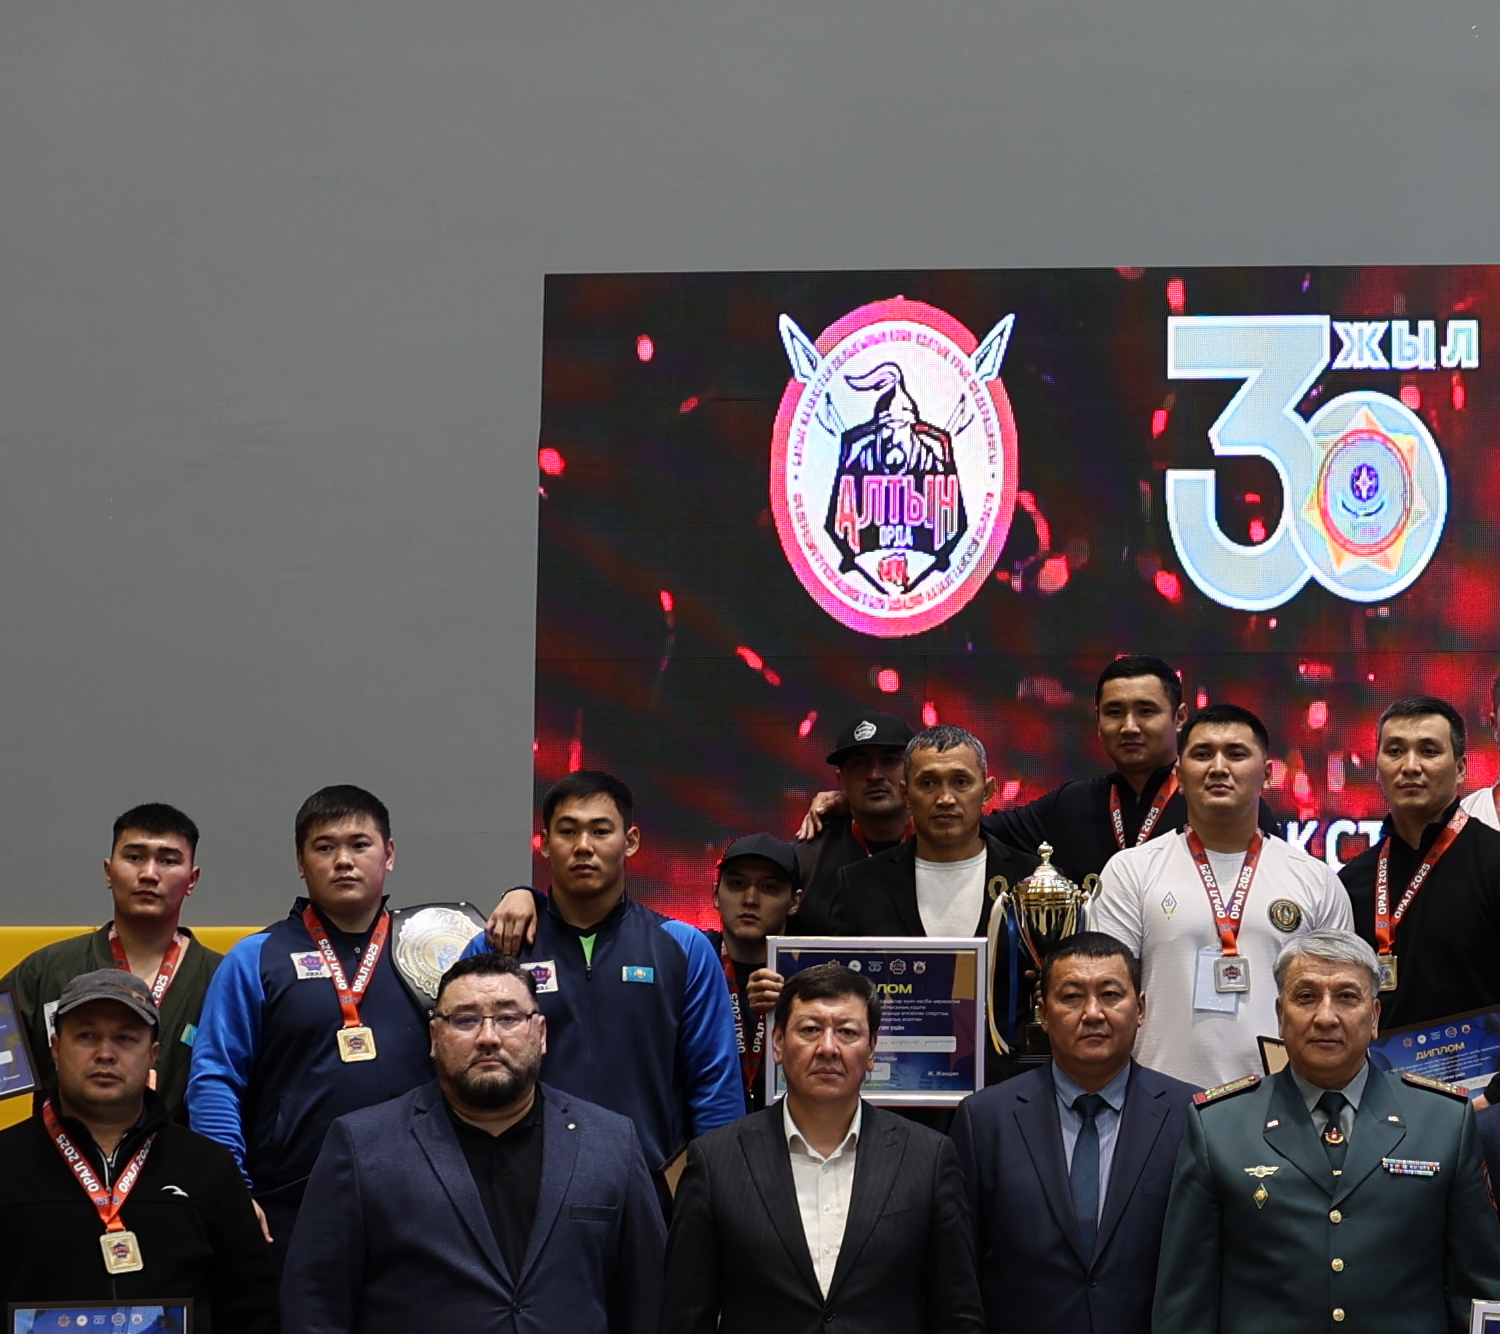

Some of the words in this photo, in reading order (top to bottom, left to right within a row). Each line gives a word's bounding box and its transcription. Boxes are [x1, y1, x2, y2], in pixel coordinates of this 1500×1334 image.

[1166, 315, 1448, 611] 30
[1331, 320, 1479, 370] ЖЫЛ
[833, 473, 960, 553] АЛТЫН
[1113, 808, 1126, 835] 2025
[1143, 806, 1160, 831] 2025
[1199, 863, 1217, 889] 2025
[1377, 857, 1389, 885] 2025
[1209, 889, 1227, 919] ОРАЛ
[1230, 890, 1247, 920] ОРАЛ
[1239, 865, 1254, 890] 2025
[1377, 884, 1389, 916] ОРАЛ
[1393, 891, 1416, 919] ОРАЛ
[1410, 863, 1431, 890] 2025
[317, 938, 338, 963] 2025
[329, 962, 348, 991] ОРАЛ
[352, 961, 372, 993] ОРАЛ
[363, 943, 379, 967] 2025
[151, 973, 168, 1004] 2025
[875, 983, 913, 994] ЛОМ
[729, 992, 743, 1021] 2025
[752, 1021, 765, 1054] ОРАЛ
[1414, 1041, 1466, 1061] ДИПЛОМ
[55, 1133, 83, 1163] 2025
[72, 1160, 102, 1193] ОРАЛ
[117, 1162, 140, 1194] ОРАЛ
